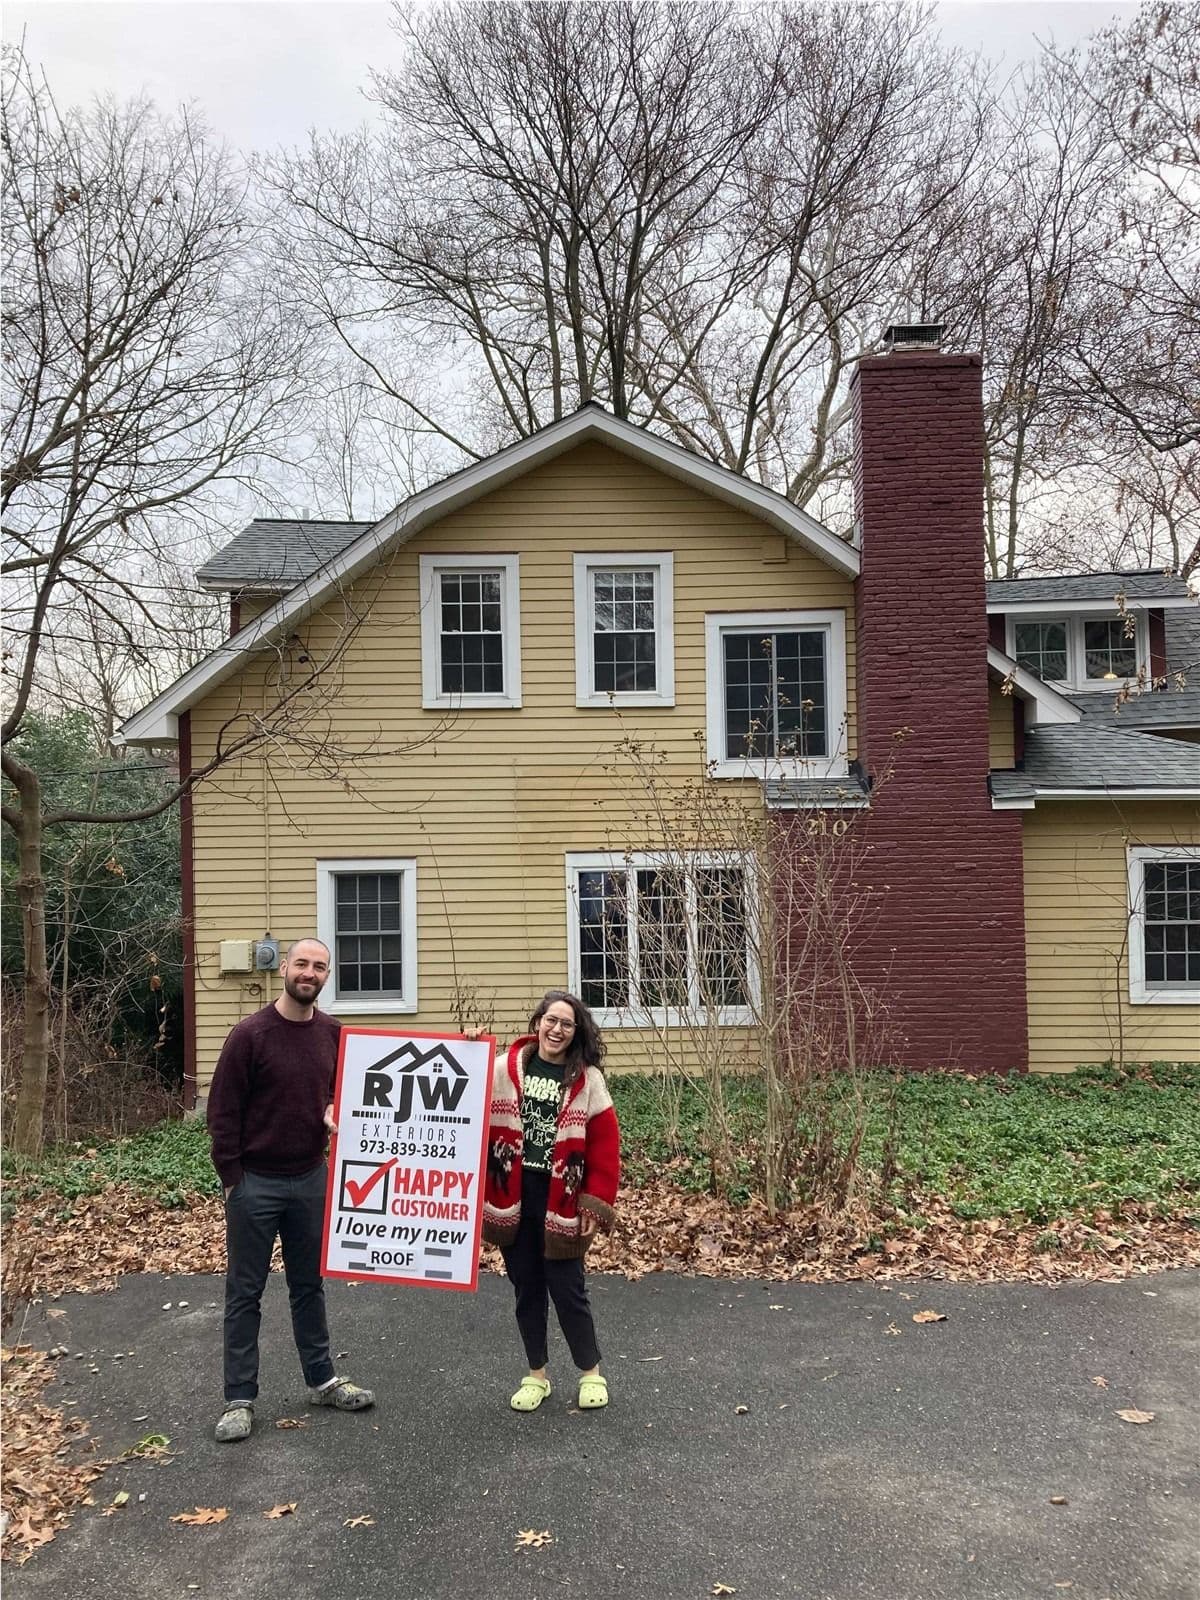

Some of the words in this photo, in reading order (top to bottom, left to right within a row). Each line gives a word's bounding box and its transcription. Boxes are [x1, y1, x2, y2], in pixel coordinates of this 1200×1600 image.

[805, 818, 849, 837] 210
[362, 1072, 470, 1124] RJW
[362, 1123, 457, 1143] EXTERIORS
[360, 1139, 457, 1159] 973-839-3824
[393, 1168, 474, 1199] HAPPY
[391, 1199, 469, 1221] CUSTOMER
[335, 1217, 343, 1234] I
[346, 1218, 387, 1238] love
[391, 1224, 422, 1245] my
[425, 1228, 467, 1245] new
[371, 1251, 414, 1266] ROOF
